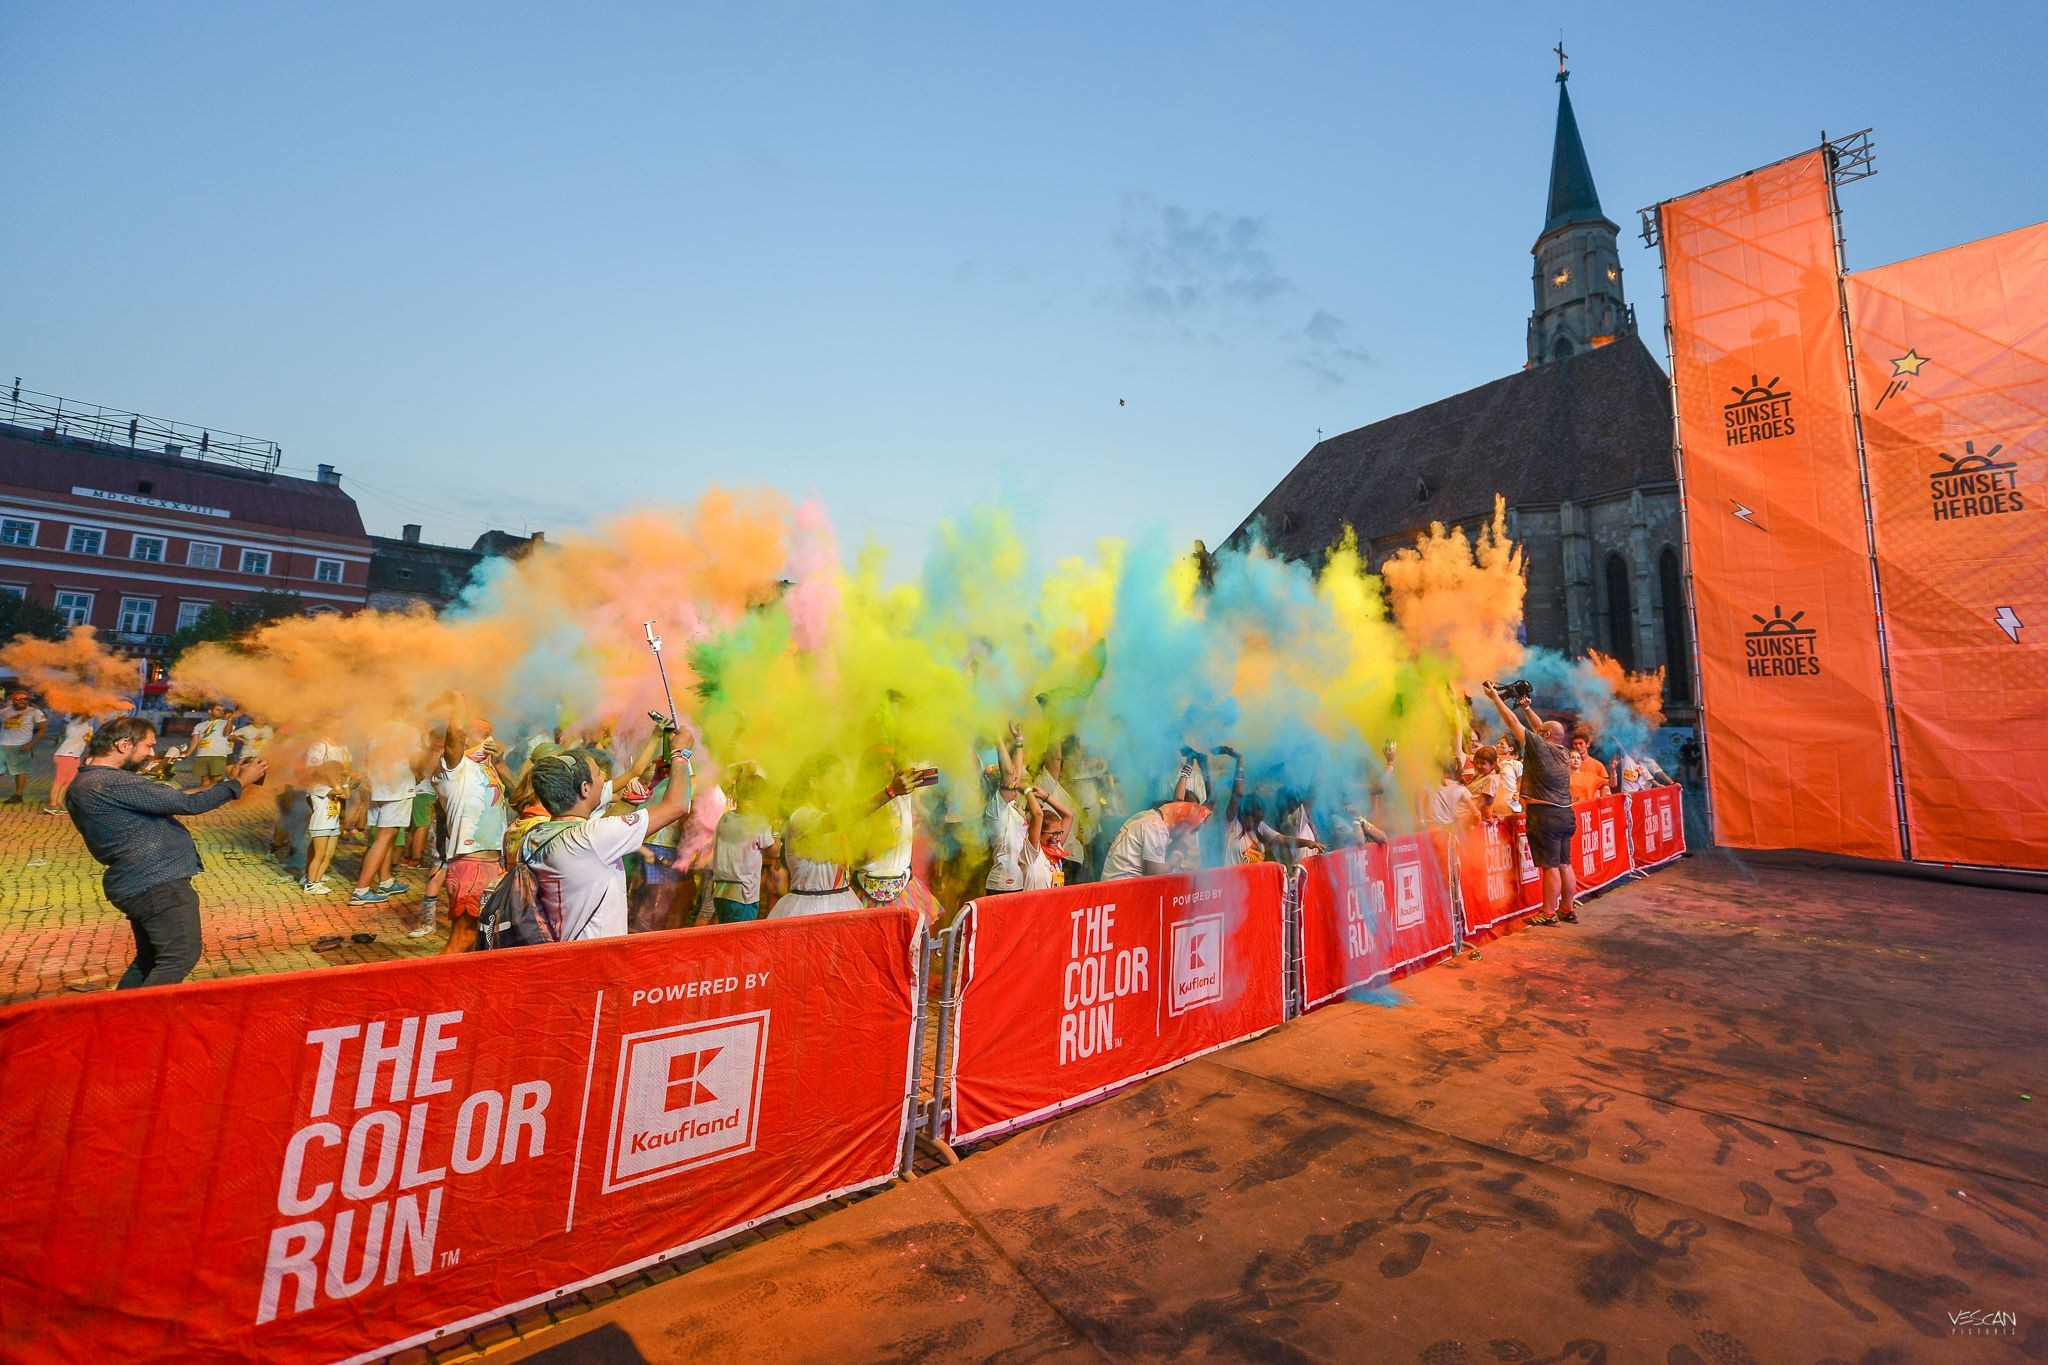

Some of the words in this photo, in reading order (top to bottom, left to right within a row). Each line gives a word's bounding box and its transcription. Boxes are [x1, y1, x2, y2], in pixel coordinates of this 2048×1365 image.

[1724, 398, 1792, 428] SUNSET
[1726, 417, 1795, 446] HEROES
[1930, 469, 2019, 500] SUNSET
[92, 490, 213, 514] MDCCCXXVIII
[1933, 491, 2024, 521] HEROES
[1745, 636, 1817, 658] SUNSET
[1747, 656, 1820, 677] HEROES
[1581, 811, 1592, 834] THE
[1581, 831, 1599, 855] COLOR
[1346, 850, 1369, 885] THE
[1485, 844, 1513, 874] COLOR
[1583, 853, 1595, 877] RUN
[1173, 891, 1211, 907] POWERED
[1212, 889, 1223, 899] BY
[1347, 880, 1386, 922] COOR
[1487, 872, 1506, 902] RUN
[1070, 904, 1116, 958] THE
[631, 975, 739, 1007] POWERED
[744, 971, 770, 991] BY
[1064, 946, 1148, 1011] COLOR
[1059, 1003, 1114, 1066] RUN
[306, 1010, 464, 1118] THE
[277, 1080, 552, 1216] COLOR
[631, 1111, 740, 1155] Kaufland
[256, 1187, 443, 1325] RUN
